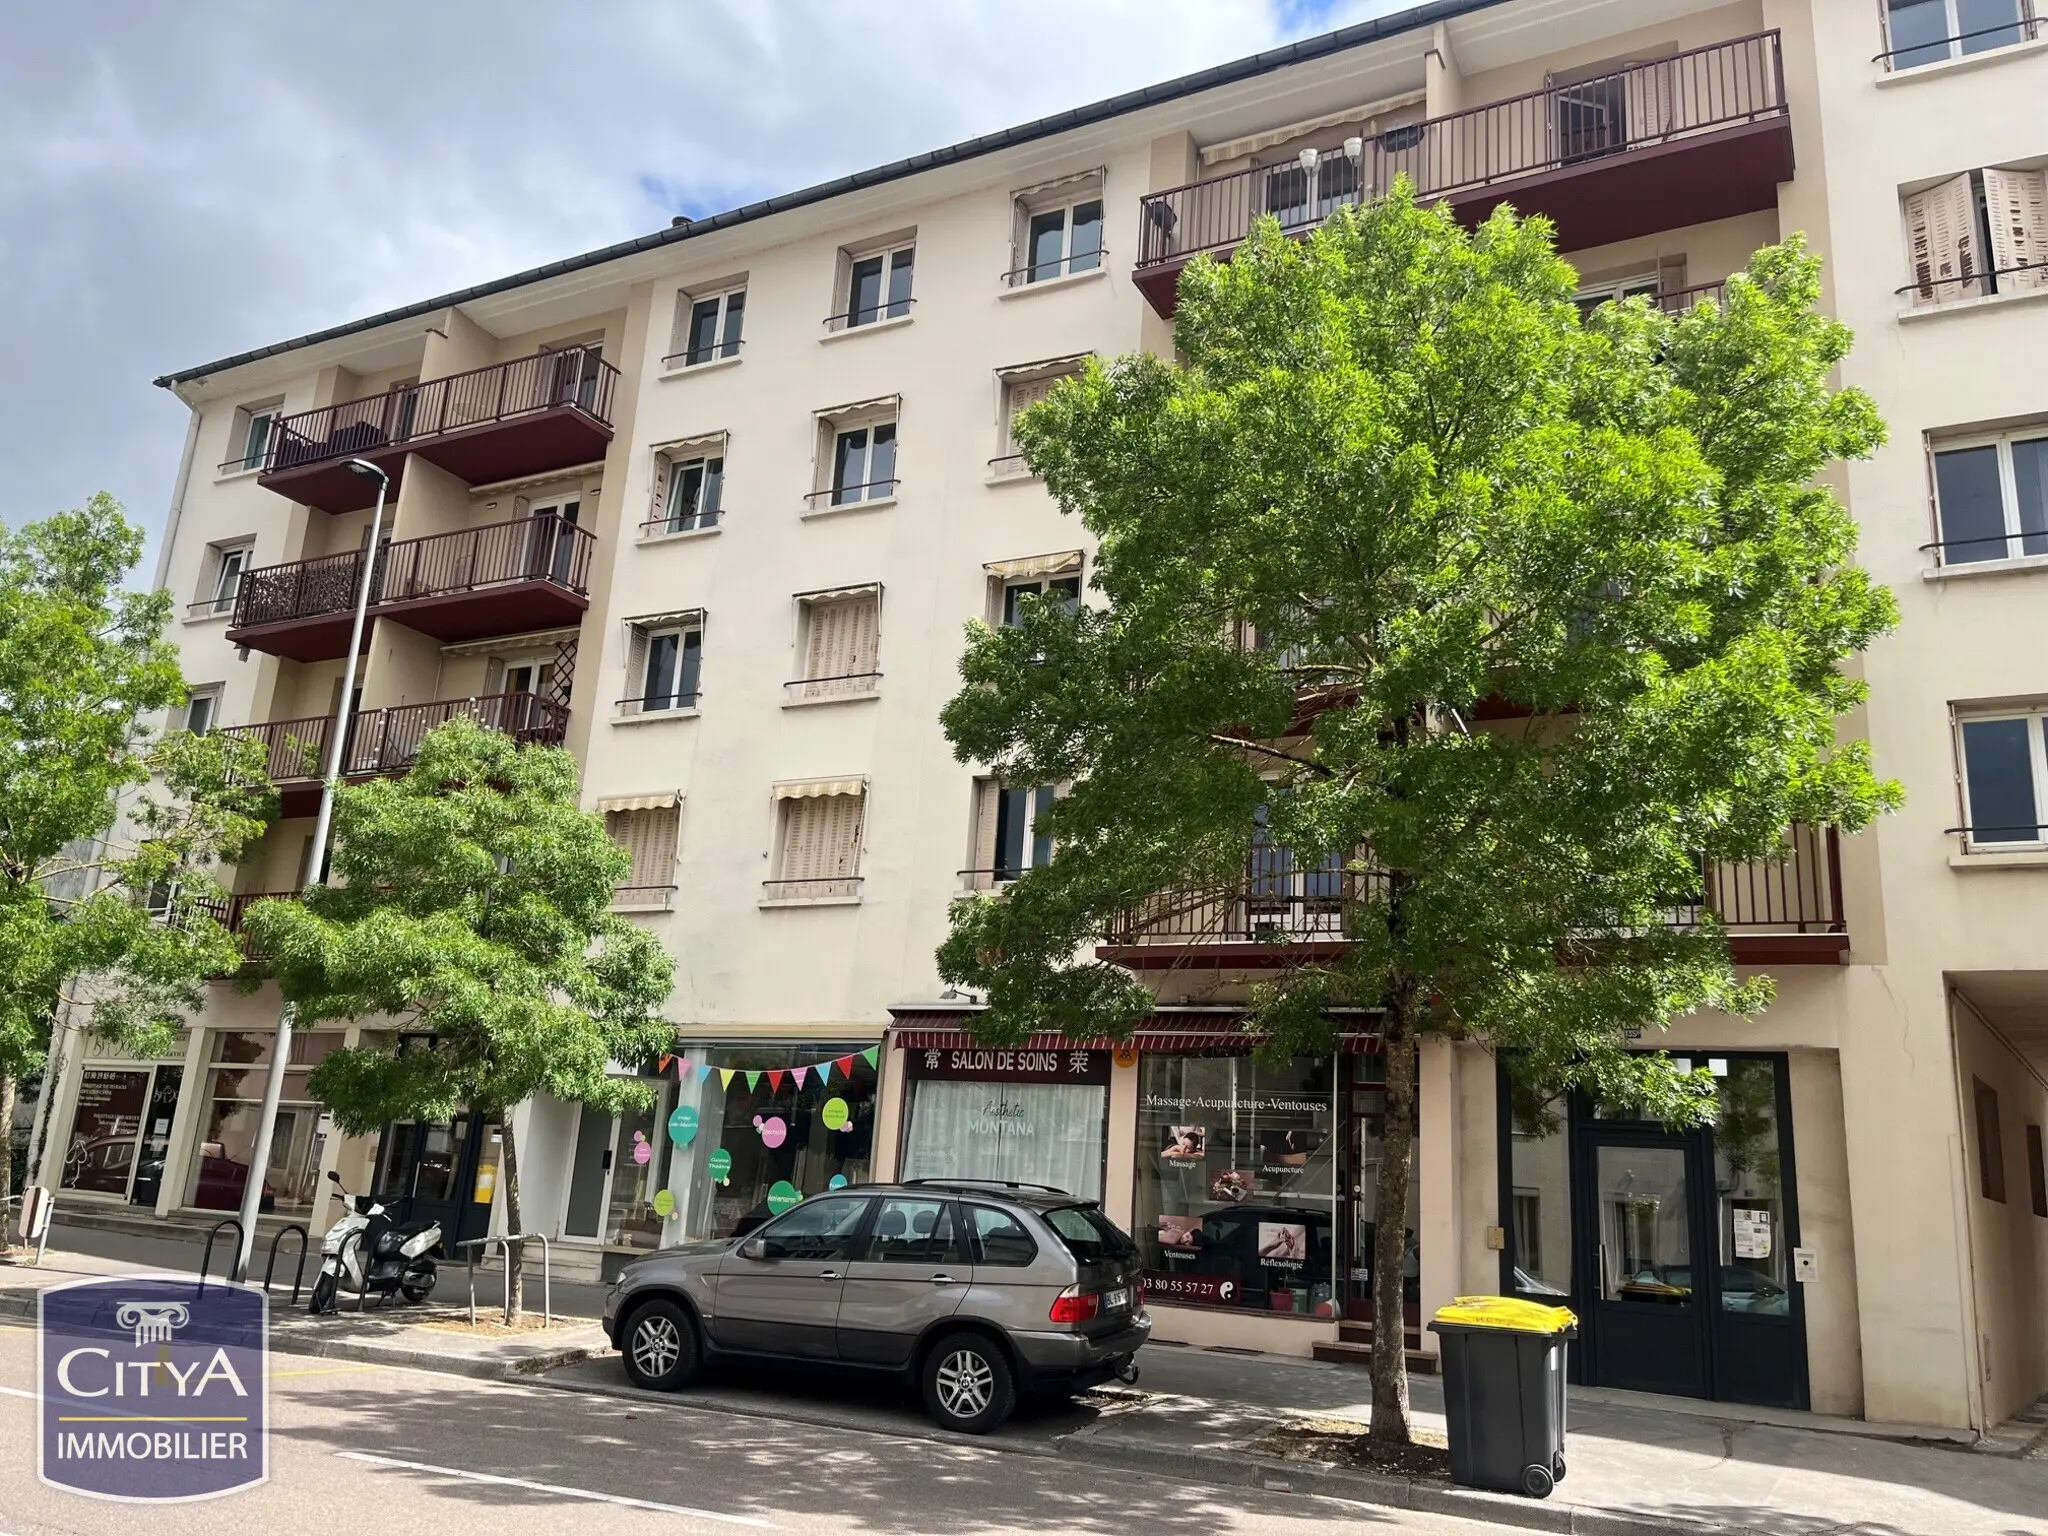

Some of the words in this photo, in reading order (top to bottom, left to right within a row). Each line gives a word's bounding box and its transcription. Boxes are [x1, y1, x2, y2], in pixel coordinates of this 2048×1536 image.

[951, 1050, 994, 1071] SALON
[997, 1051, 1014, 1071] DE
[1017, 1051, 1058, 1072] SOINS
[982, 1100, 1025, 1118] Aesthetic
[969, 1119, 1035, 1136] MONTANA
[1169, 1159, 1197, 1170] Massage
[1262, 1164, 1304, 1174] Acupuncture
[1164, 1250, 1196, 1260] Ventouses
[1260, 1258, 1303, 1270] Réflexologie
[1155, 1278, 1168, 1291] 80
[1170, 1279, 1183, 1292] 55
[1185, 1281, 1198, 1294] 57
[1201, 1282, 1214, 1295] 27
